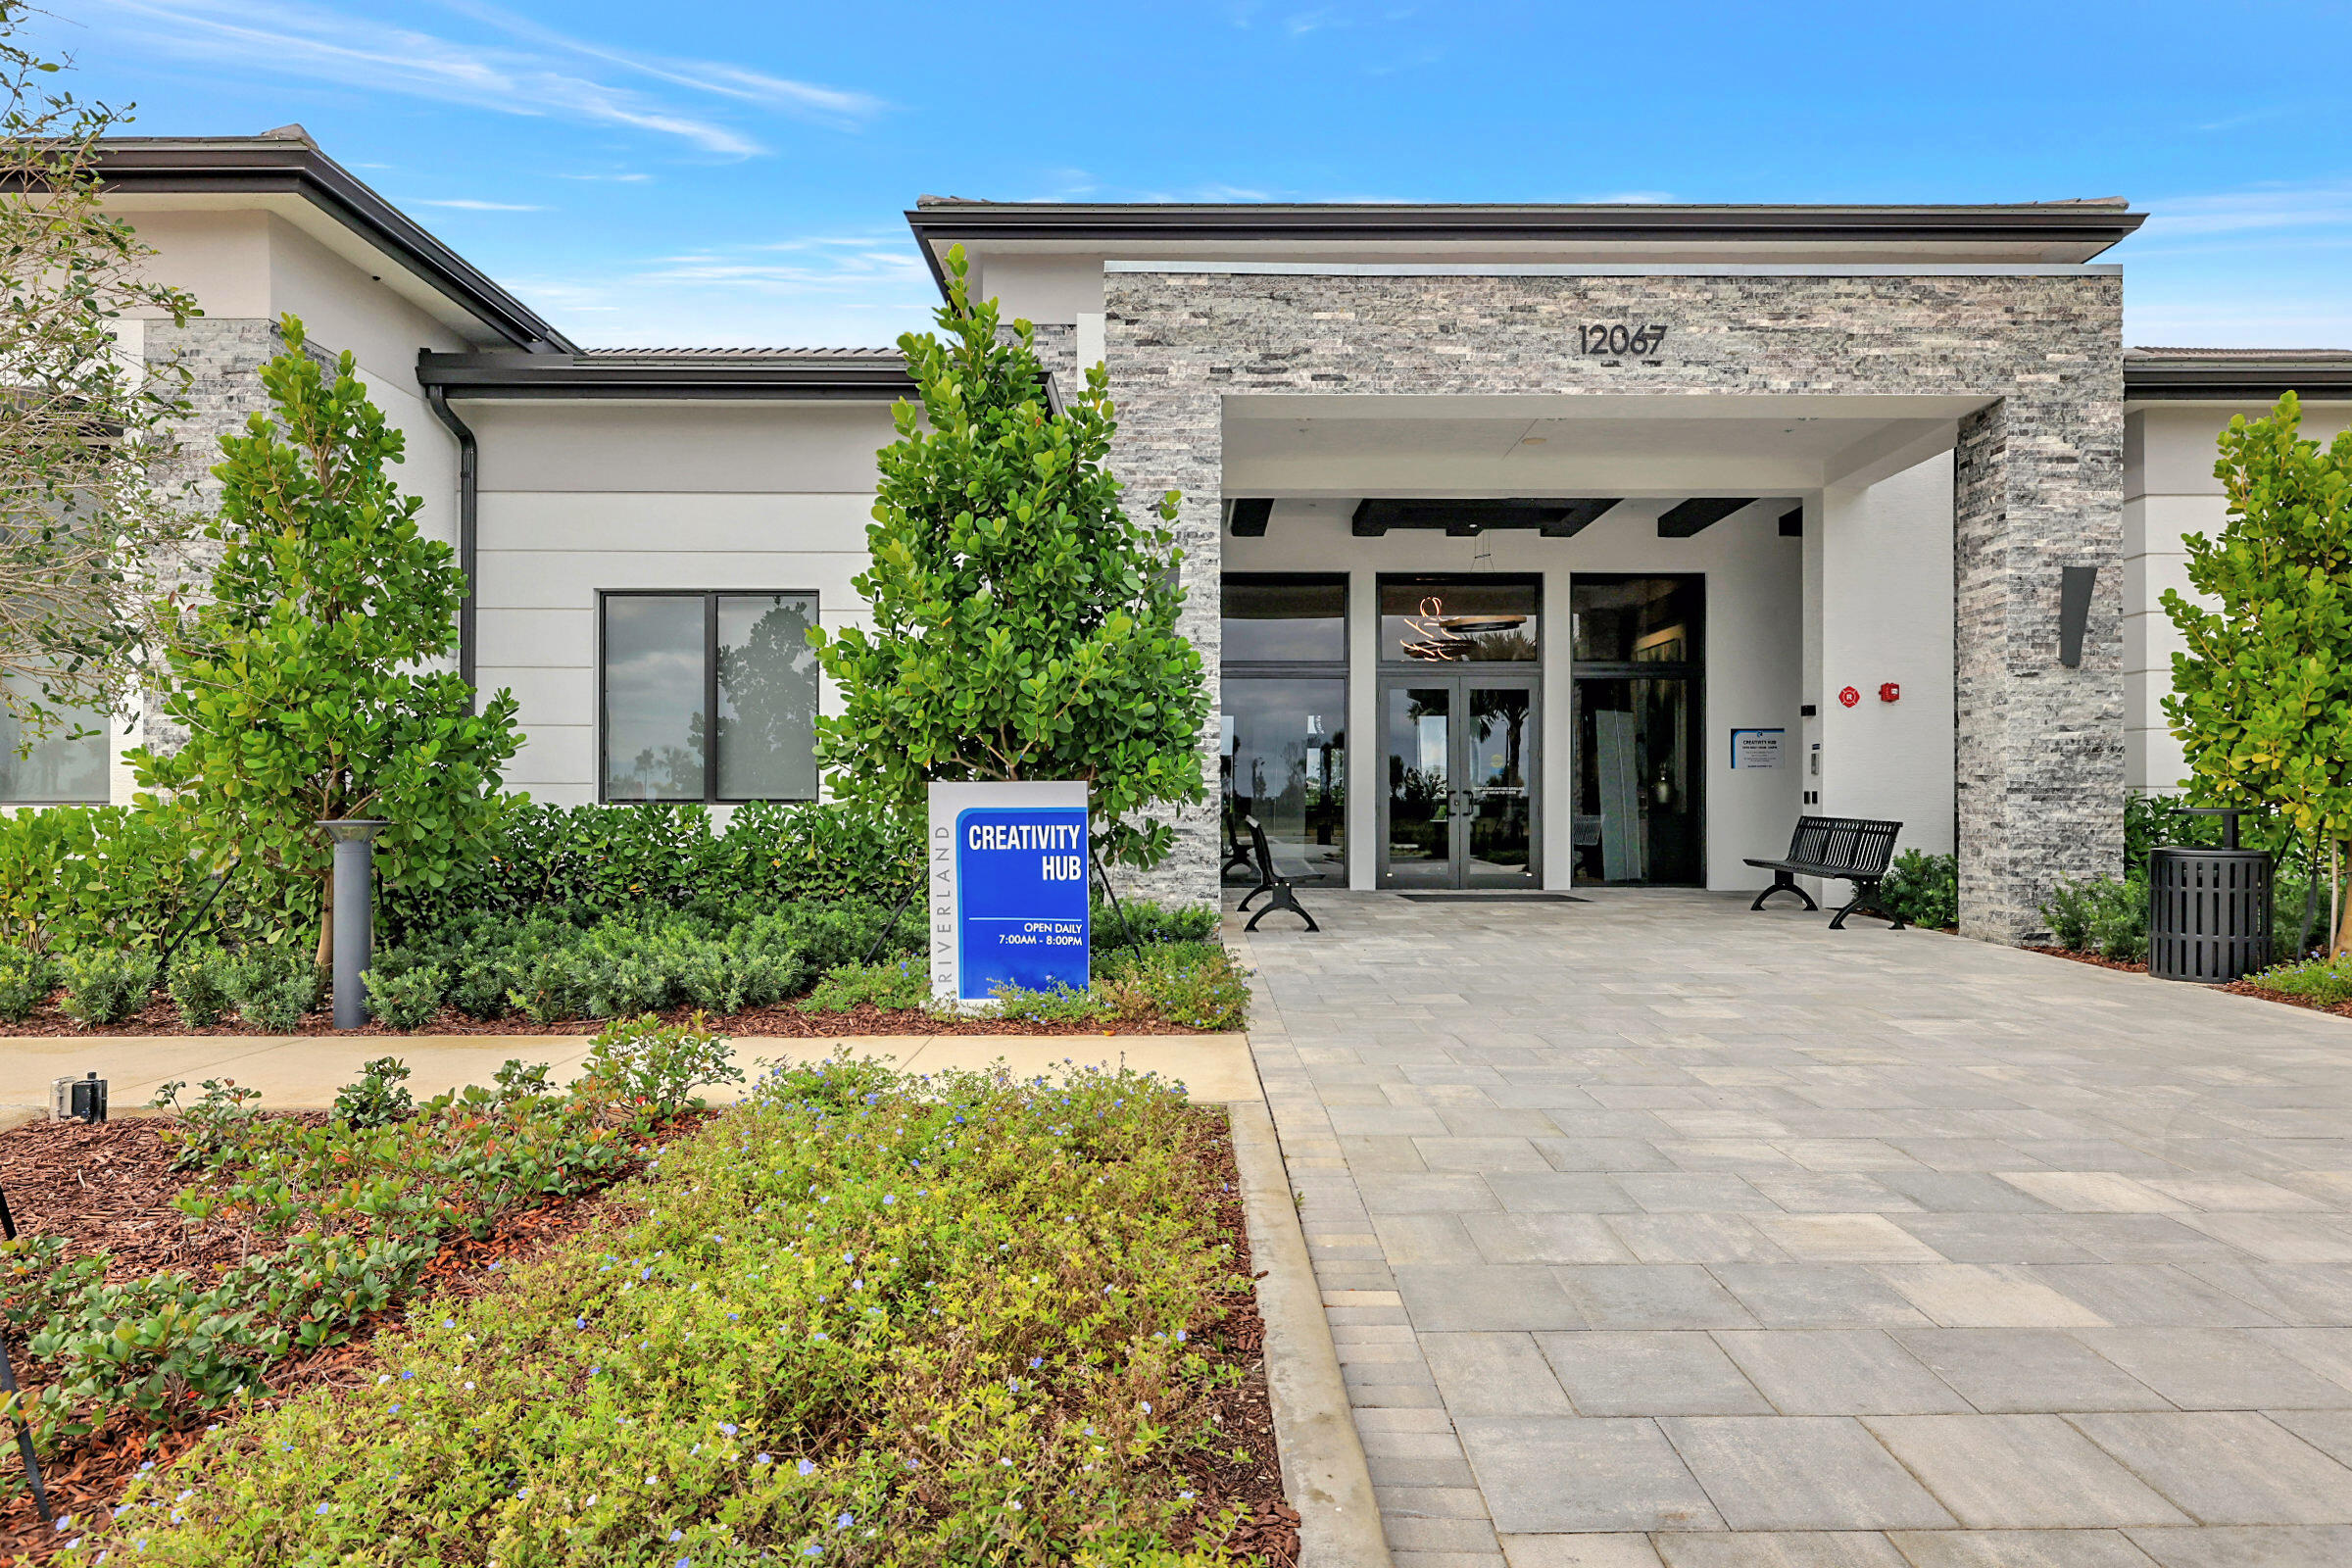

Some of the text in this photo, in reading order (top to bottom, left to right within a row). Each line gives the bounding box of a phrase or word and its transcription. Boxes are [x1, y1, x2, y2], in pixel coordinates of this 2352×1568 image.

[1578, 324, 1668, 355] 12067
[968, 824, 1081, 851] CREATIVITY
[1042, 856, 1082, 881] HUB
[935, 826, 953, 983] RIVERLAND
[999, 934, 1037, 945] 7:00AM
[1046, 936, 1083, 946] 8:00PM
[1024, 922, 1083, 934] OPEN DAILY
